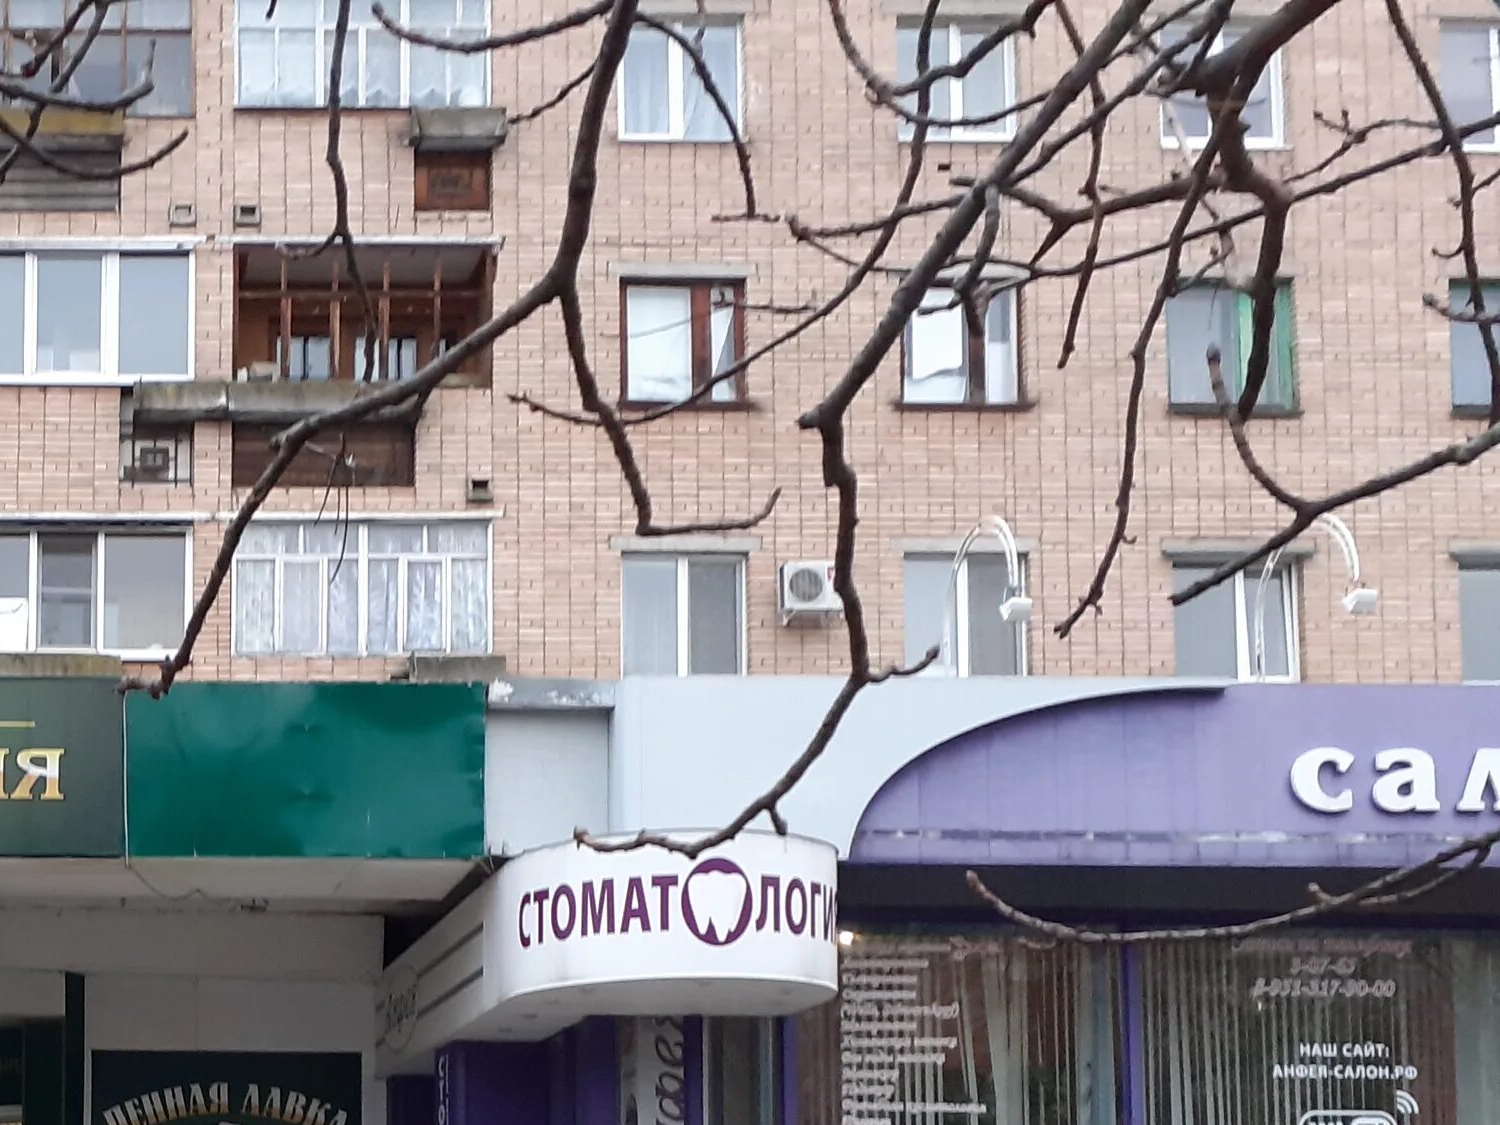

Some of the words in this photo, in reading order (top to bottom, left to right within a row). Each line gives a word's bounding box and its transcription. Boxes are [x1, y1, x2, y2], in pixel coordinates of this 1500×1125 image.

[518, 857, 838, 948] СТОМАТОЛОГИ
[1300, 1043, 1337, 1057] НАШ
[1343, 1041, 1390, 1058] САЙТ:
